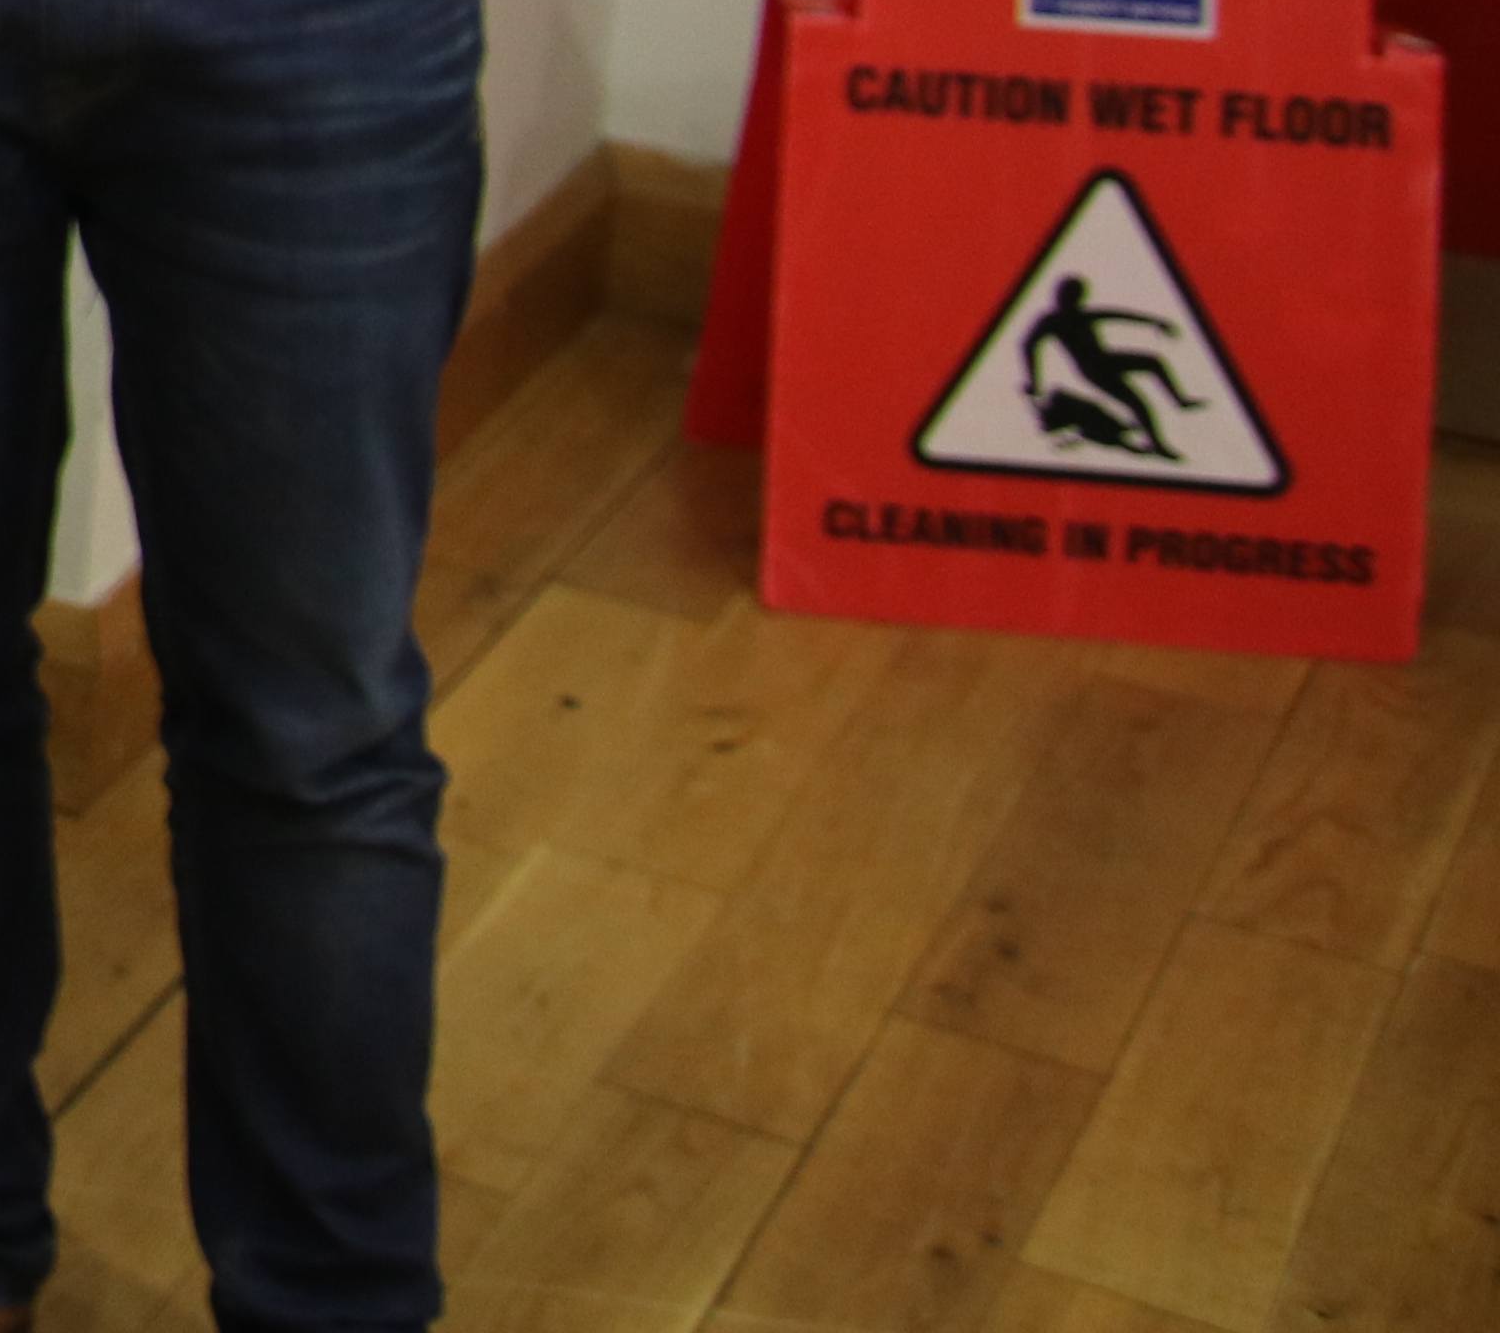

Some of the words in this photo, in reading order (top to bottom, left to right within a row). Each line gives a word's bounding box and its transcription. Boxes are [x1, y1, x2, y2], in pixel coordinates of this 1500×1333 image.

[846, 64, 1071, 126] CAUTION
[1087, 82, 1203, 133] WET
[1220, 90, 1394, 151] FLOOR
[822, 498, 1049, 559] CLEANING
[1062, 520, 1112, 563] IN
[1123, 524, 1377, 588] PROGRESS
